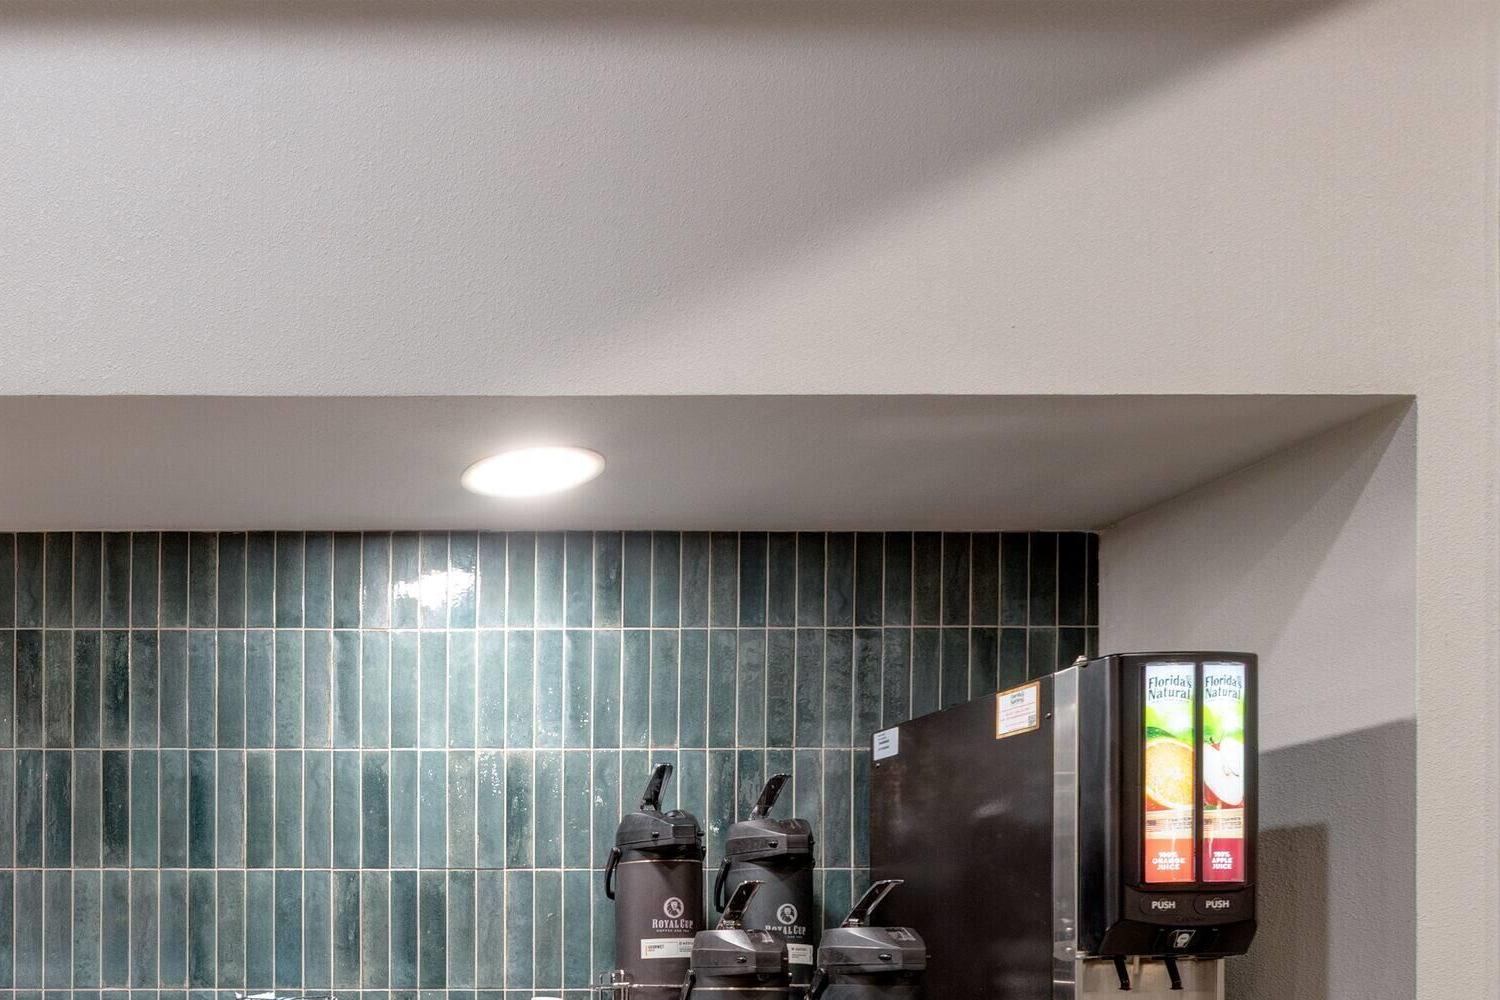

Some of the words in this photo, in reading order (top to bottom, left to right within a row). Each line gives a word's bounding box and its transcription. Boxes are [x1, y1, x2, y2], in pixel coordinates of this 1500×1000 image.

[1148, 688, 1191, 700] Natural
[1205, 687, 1241, 699] Natural
[1151, 901, 1176, 909] PUSH
[1205, 900, 1230, 909] PUSH
[651, 918, 679, 929] ROYAL
